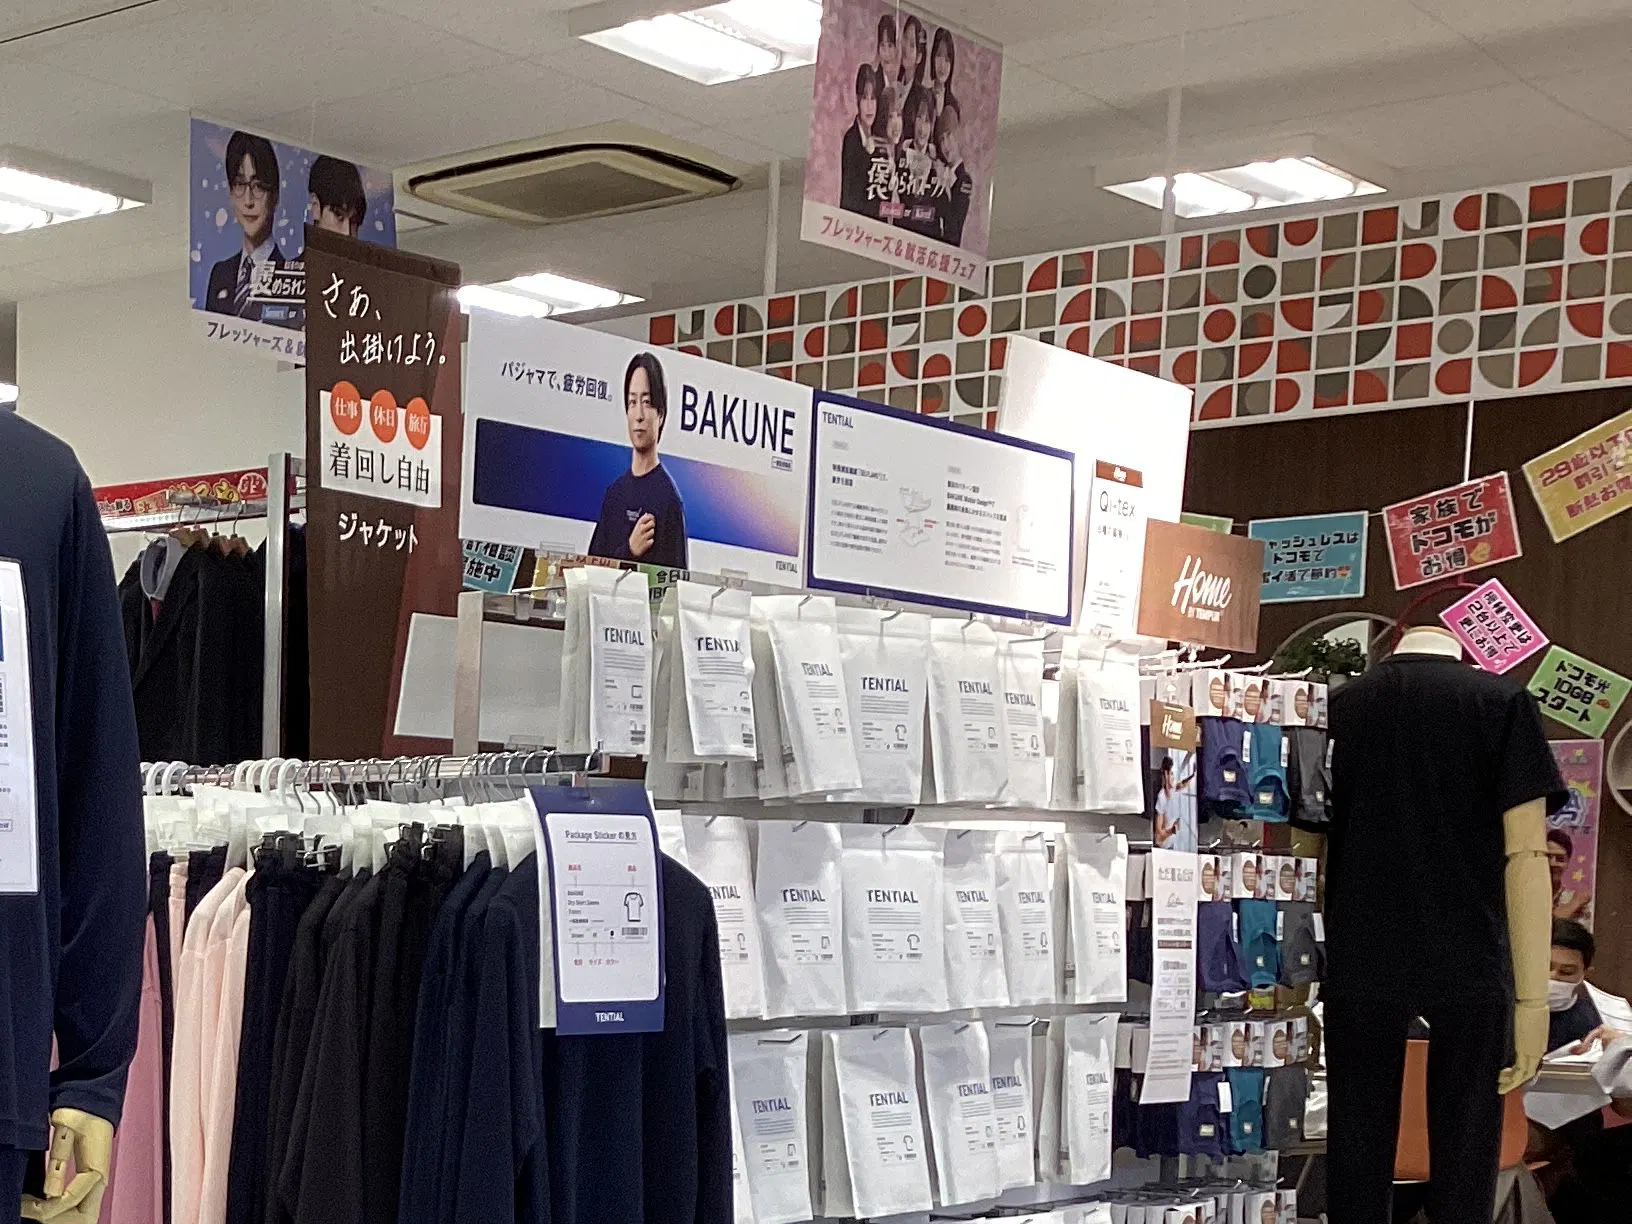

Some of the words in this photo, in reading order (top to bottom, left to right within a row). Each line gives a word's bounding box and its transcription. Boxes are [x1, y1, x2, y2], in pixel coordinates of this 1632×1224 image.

[322, 272, 382, 320] さあ、
[340, 330, 447, 365] 出掛けよう。
[501, 360, 613, 402] パジャマで、疲労回復。
[335, 397, 358, 419] 仕事
[374, 405, 395, 427] 休日
[409, 412, 428, 435] 旅行
[680, 384, 795, 455] BAKUNE
[822, 411, 854, 429] TENTIAL
[330, 441, 430, 495] 着回し自由
[1410, 486, 1484, 525] 家族で
[339, 513, 418, 553] ジャケット
[1269, 532, 1359, 549] ャッシュレスは
[1411, 510, 1497, 554] ドコモが
[1421, 547, 1466, 577] お得
[1171, 555, 1232, 614] Home
[604, 627, 645, 646] TENTIAL
[1468, 600, 1518, 655] 2台以上で
[801, 662, 833, 677] TENTIAL
[1555, 659, 1611, 694] ドコモ光
[861, 676, 909, 692] TENTIAL
[958, 680, 993, 695] TENTIAL
[1554, 677, 1595, 704] 10GB
[1004, 692, 1036, 706] TENTIAL
[1100, 698, 1129, 712] TENTIAL
[1538, 686, 1590, 722] スタート
[709, 886, 741, 899] ENTIAL
[782, 888, 826, 902] TENTIAL
[867, 889, 918, 903] TENTIAL
[956, 890, 989, 903] TENTIAL
[1018, 892, 1045, 904] TENTIAL
[595, 1012, 624, 1022] TENTIAL
[958, 1083, 988, 1097] TENTIAL
[992, 1076, 1022, 1090] TENTIAL
[753, 1098, 791, 1113] TENTIAL
[869, 1091, 909, 1107] TENTIAL
